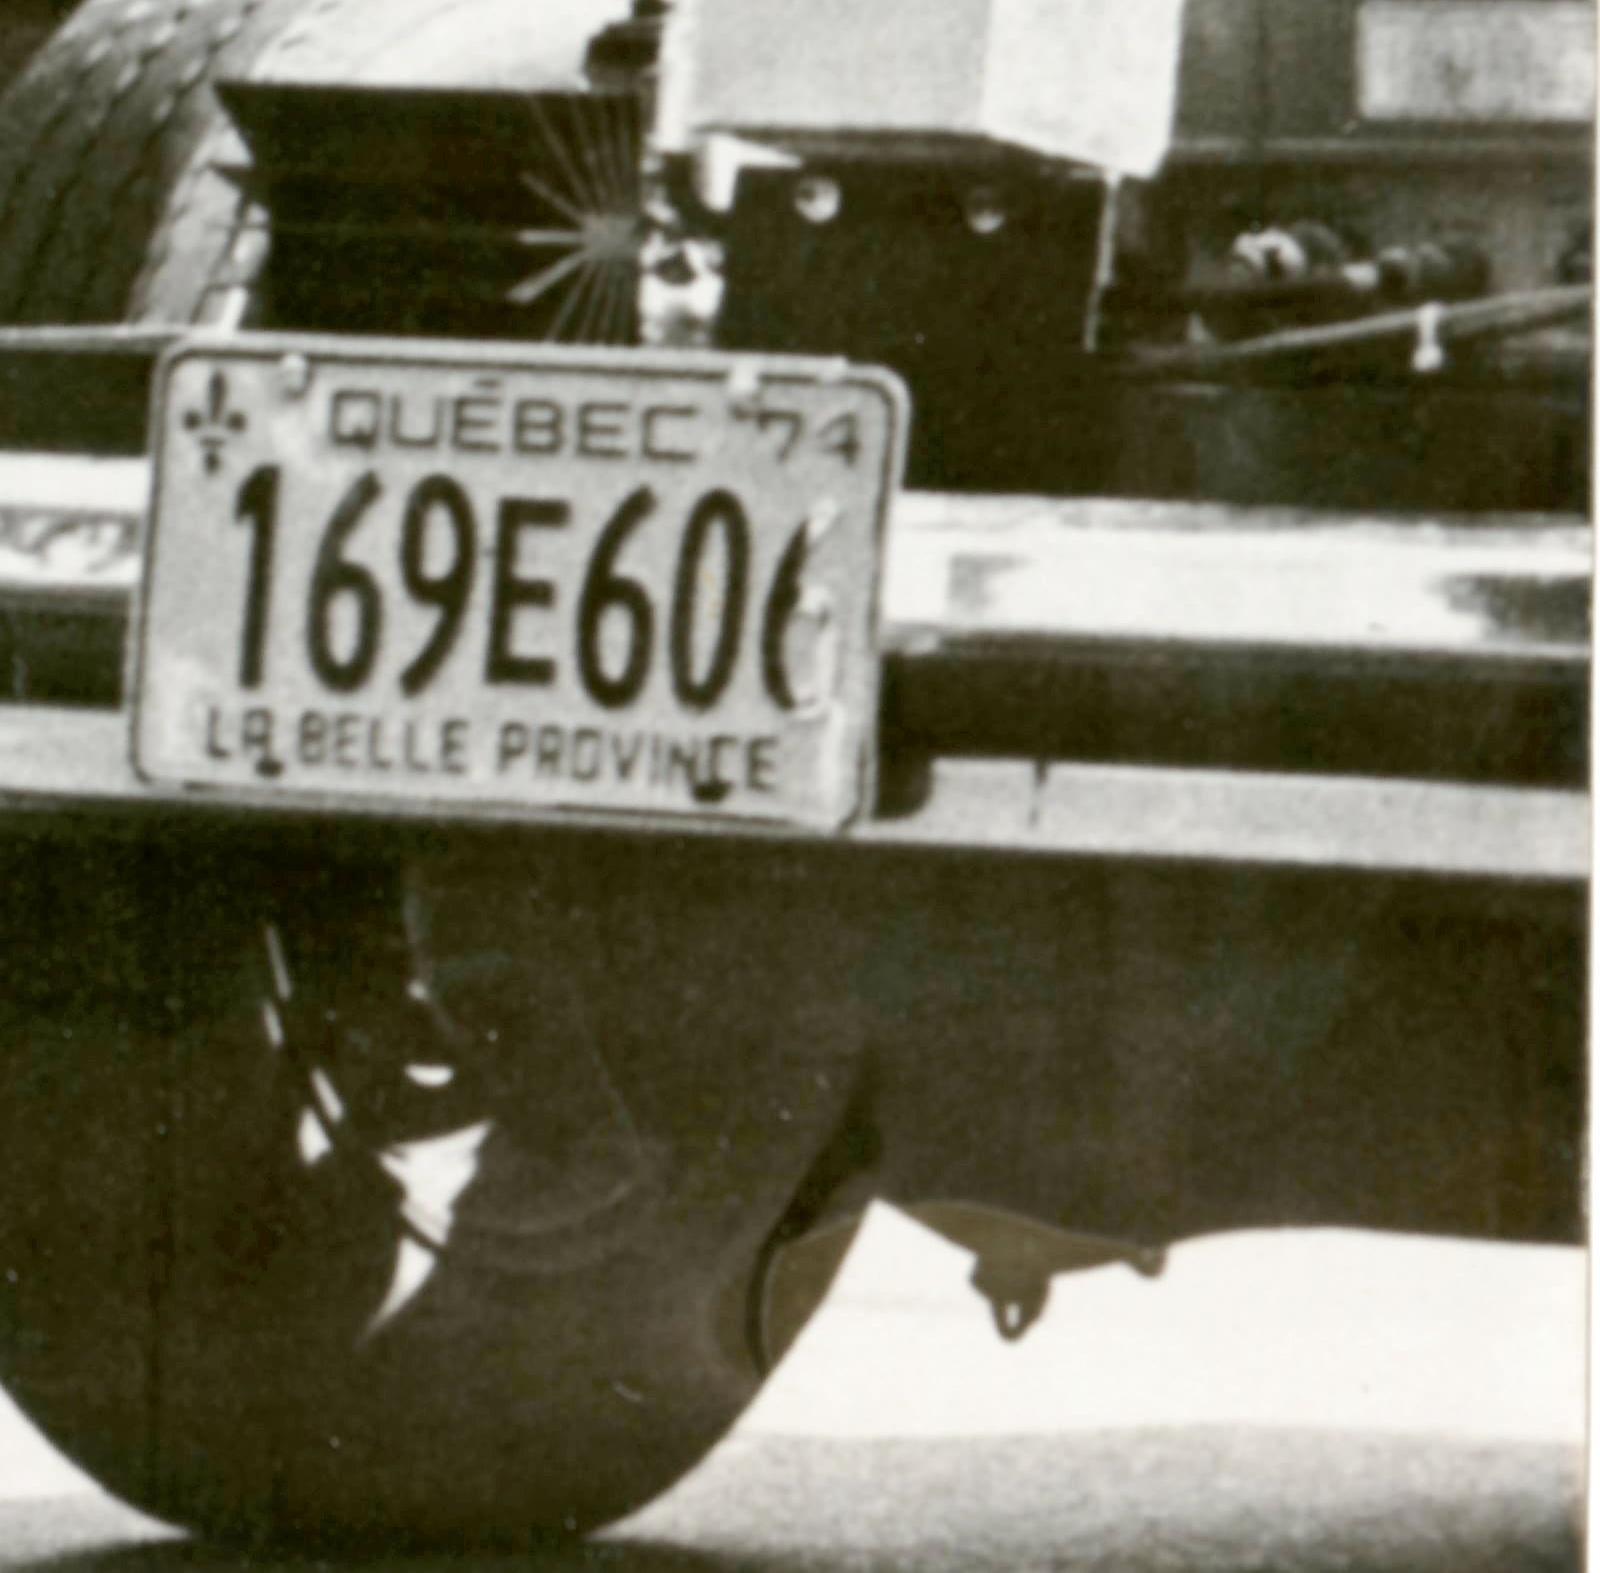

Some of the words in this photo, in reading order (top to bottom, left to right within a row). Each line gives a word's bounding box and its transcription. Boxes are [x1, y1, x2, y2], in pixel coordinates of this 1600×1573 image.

[329, 378, 702, 463] QUÉBEC
[206, 706, 276, 760] LA
[299, 709, 469, 775] BELLE
[498, 720, 780, 792] PROVINCE
